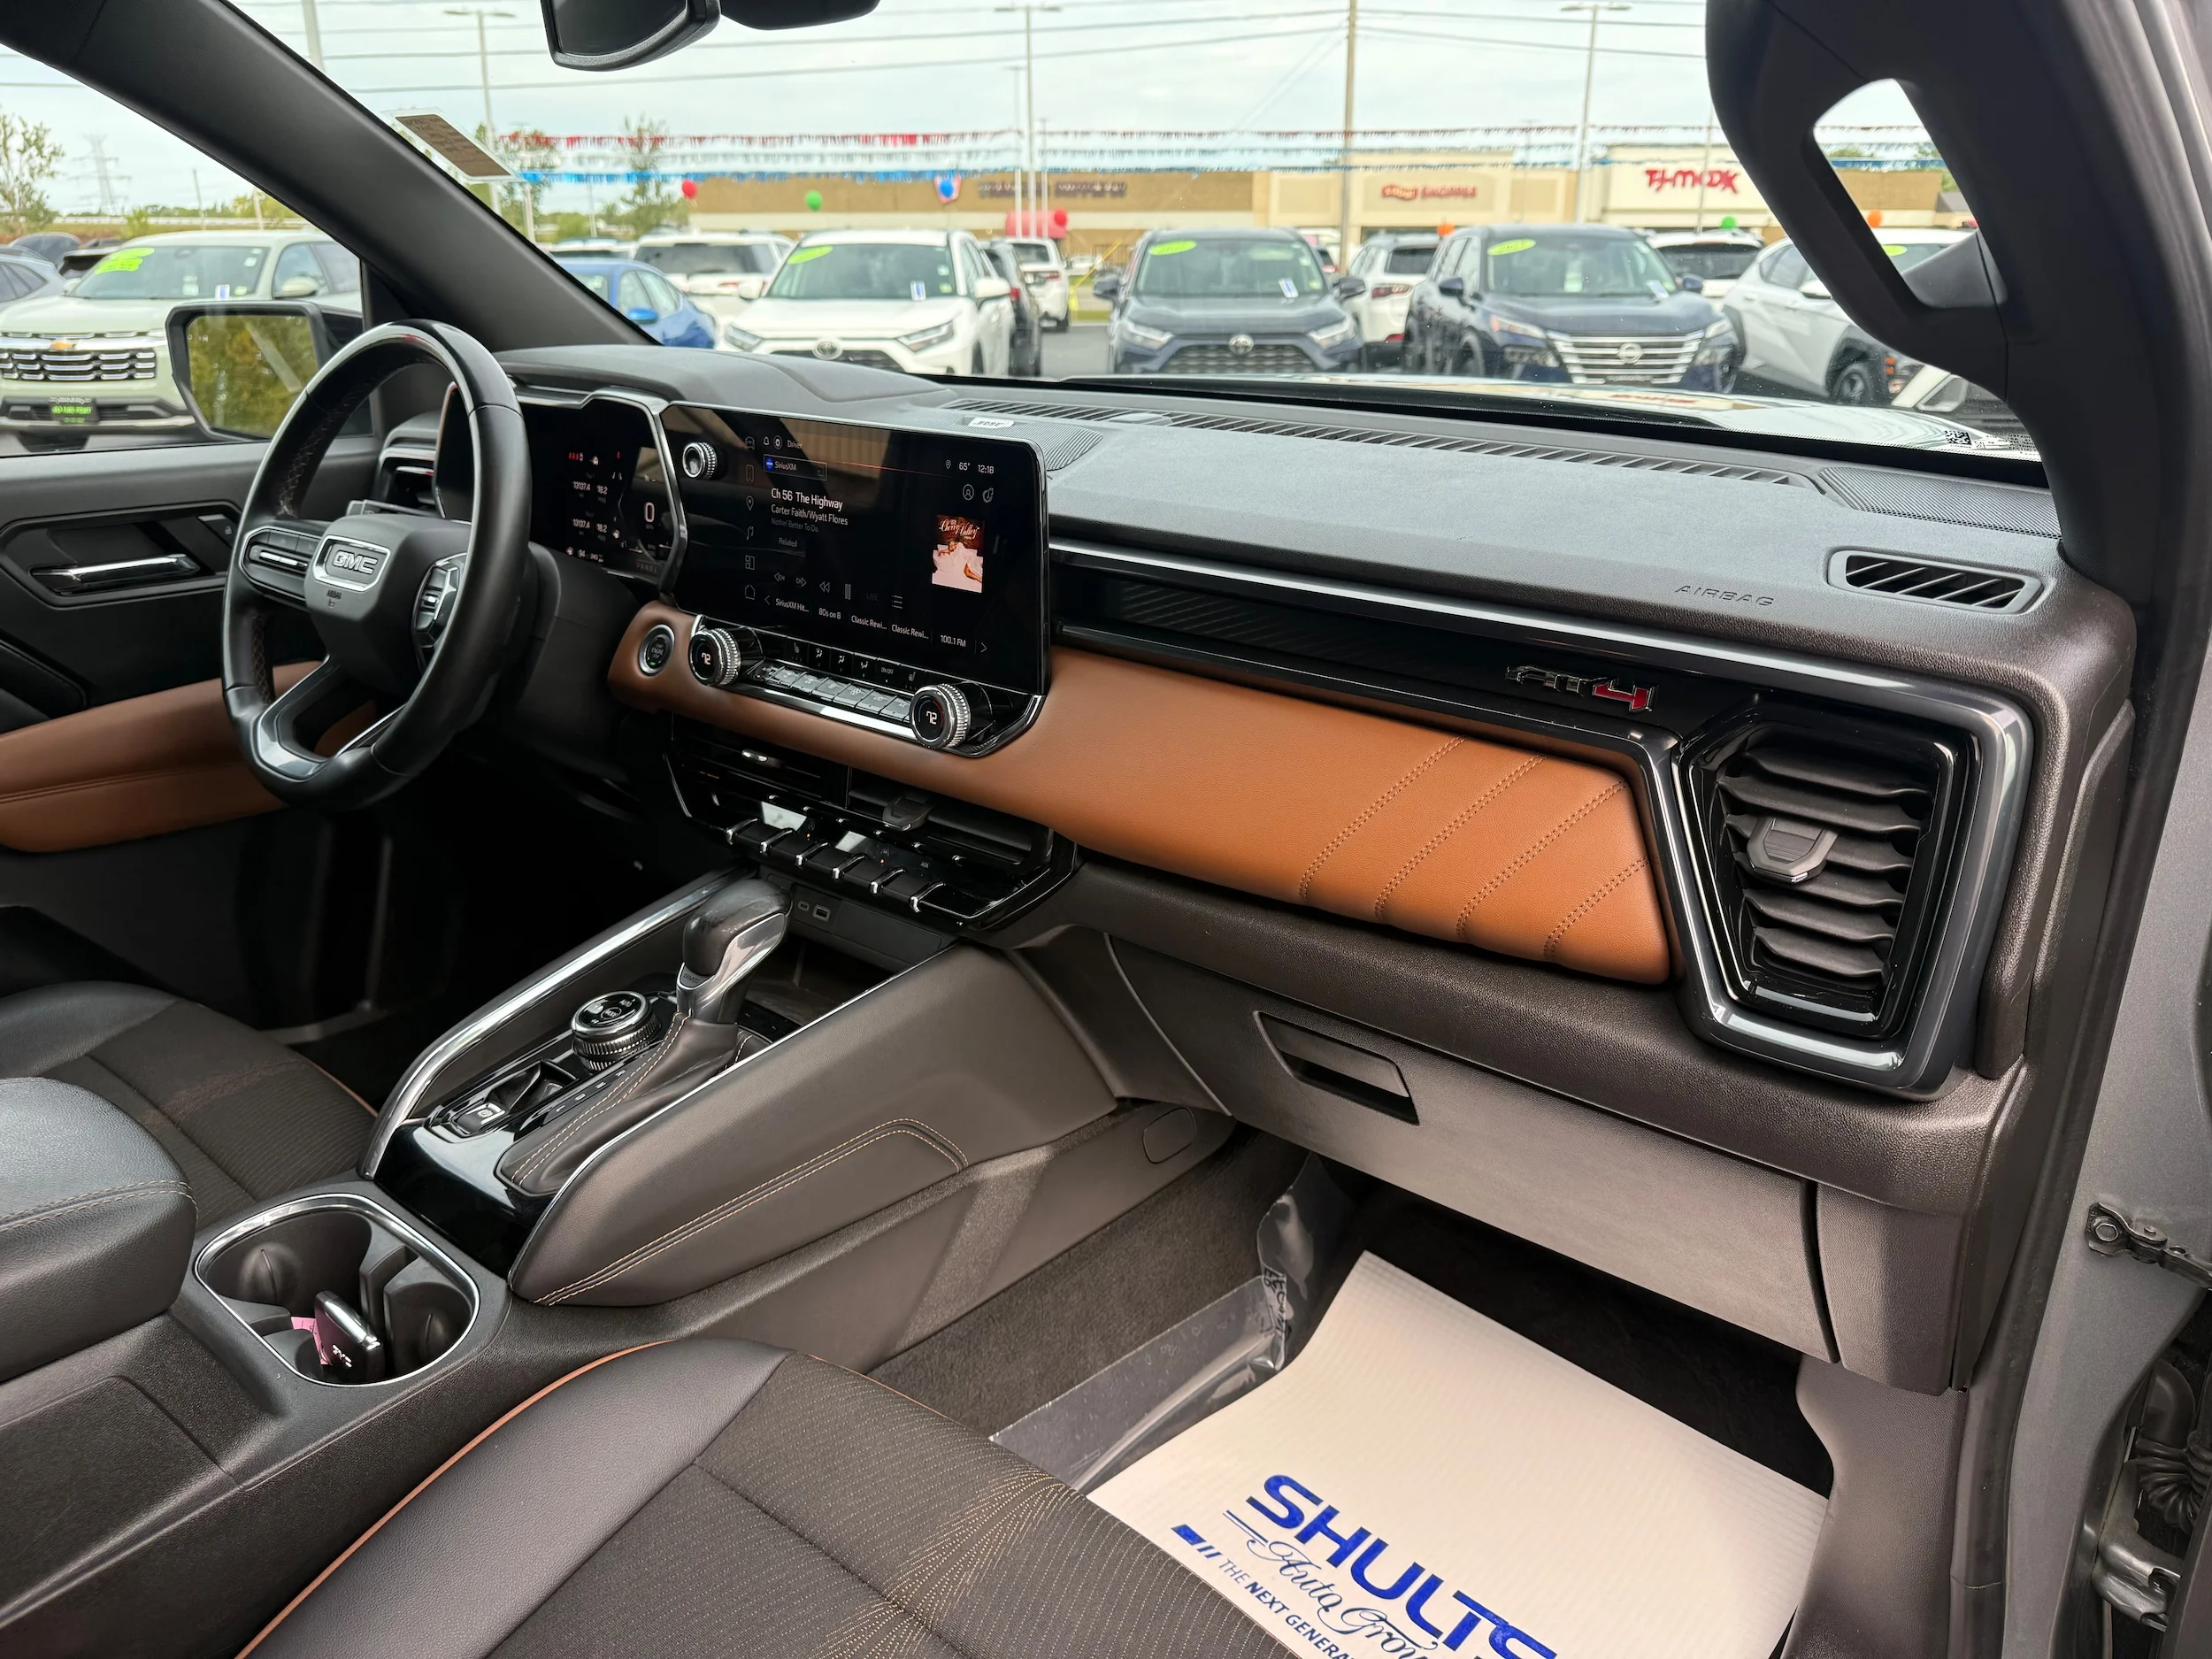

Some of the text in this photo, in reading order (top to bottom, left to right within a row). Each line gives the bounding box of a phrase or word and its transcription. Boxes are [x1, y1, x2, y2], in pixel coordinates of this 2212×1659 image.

[787, 440, 803, 449] Driver
[774, 461, 797, 472] SiriusXM
[978, 465, 995, 474] 12:18
[771, 488, 843, 512] Ch 56 The Highway
[771, 503, 849, 526] Carter Faith/Wyatt Flores
[787, 520, 803, 530] Better
[810, 524, 819, 533] Do
[779, 537, 798, 548] Related
[333, 549, 378, 575] GMC
[1675, 584, 1775, 607] AIRBAG
[775, 598, 797, 610] SiriusXM
[818, 608, 829, 618] 80s
[850, 615, 870, 626] Classic
[891, 624, 910, 635] Classic
[940, 634, 967, 648] 100.1 FM
[701, 652, 711, 665] 72
[926, 710, 938, 725] 72
[1245, 1474, 1558, 1659] SHULTS
[1247, 1540, 1343, 1613] Auto
[1218, 1558, 1251, 1585] THE
[1244, 1581, 1290, 1615] NEXT
